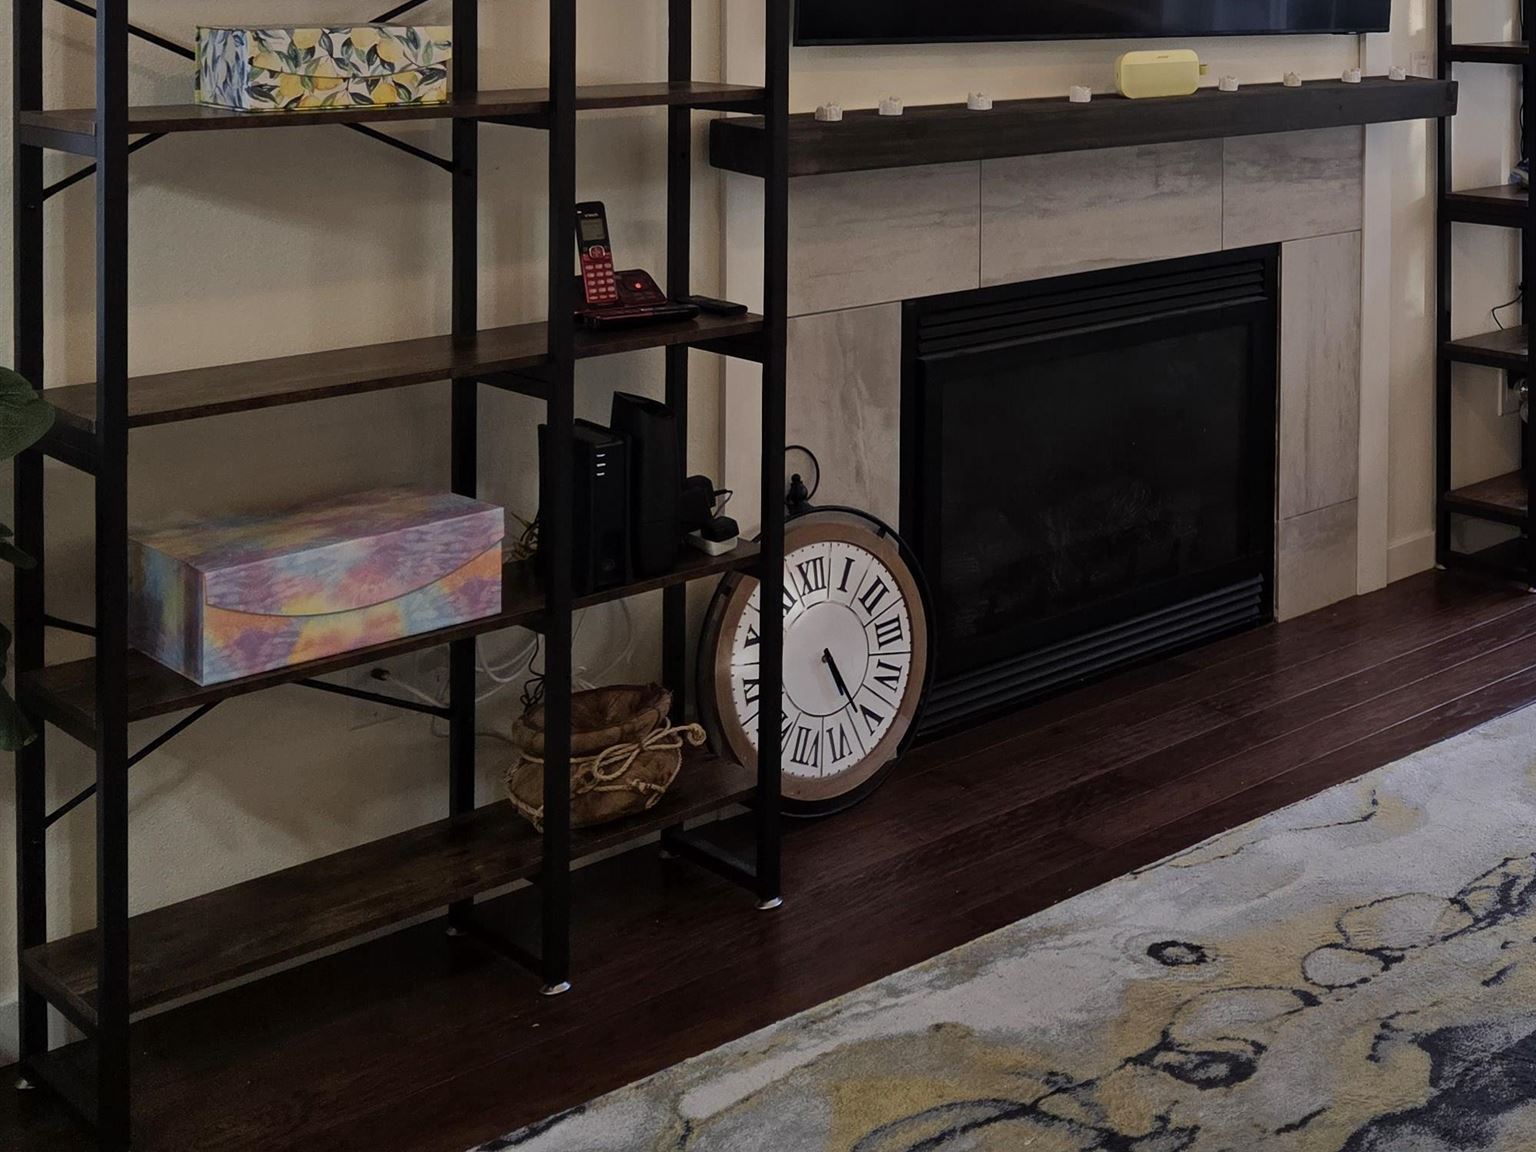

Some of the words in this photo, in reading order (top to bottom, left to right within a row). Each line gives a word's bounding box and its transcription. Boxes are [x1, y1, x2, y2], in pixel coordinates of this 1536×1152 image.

[796, 556, 827, 596] XII
[837, 557, 855, 592] I
[858, 575, 890, 616] II
[874, 614, 903, 650] III
[873, 659, 903, 693] IV
[859, 704, 885, 736] V
[790, 726, 820, 768] VII
[826, 723, 853, 763] VI
